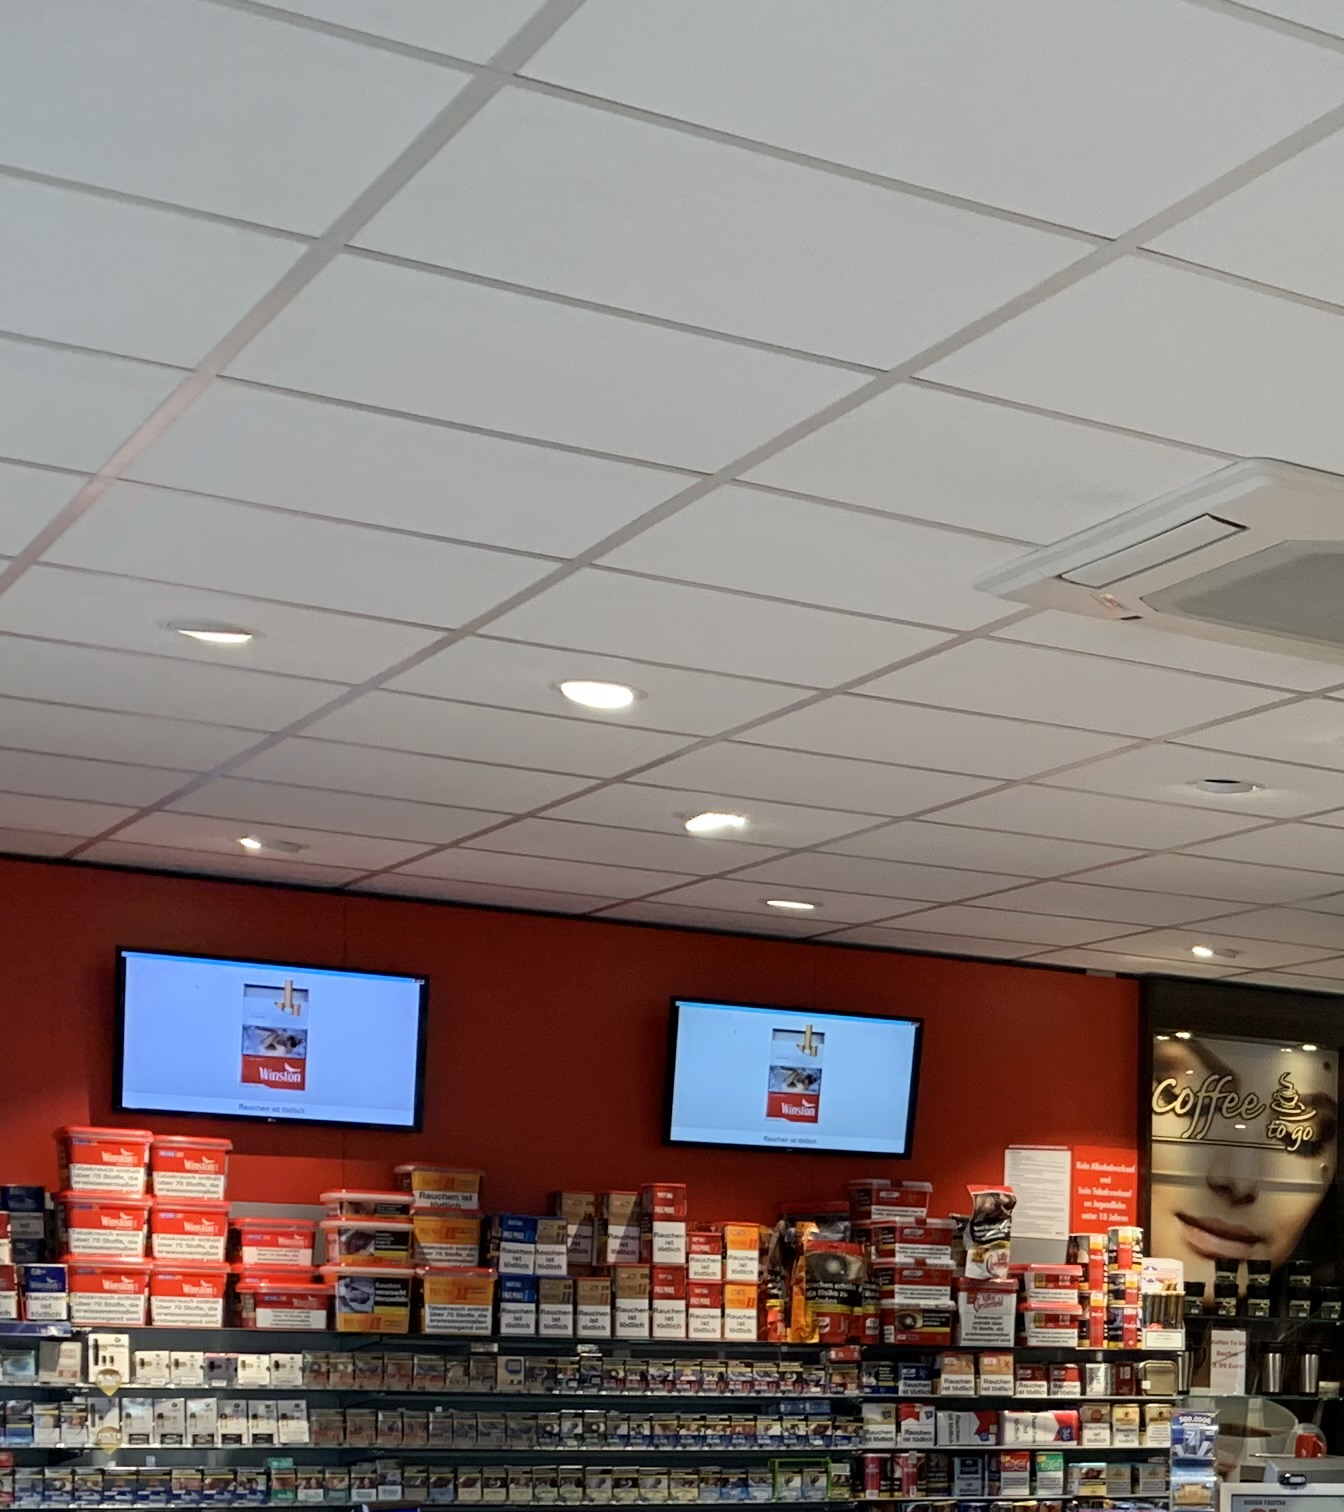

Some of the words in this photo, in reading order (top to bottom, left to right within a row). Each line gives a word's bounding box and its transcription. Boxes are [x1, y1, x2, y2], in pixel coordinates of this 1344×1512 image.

[258, 1065, 301, 1083] Winston
[781, 1101, 816, 1117] Winston
[1152, 1074, 1266, 1139] Coffee
[1267, 1121, 1286, 1139] to
[1287, 1125, 1314, 1151] go
